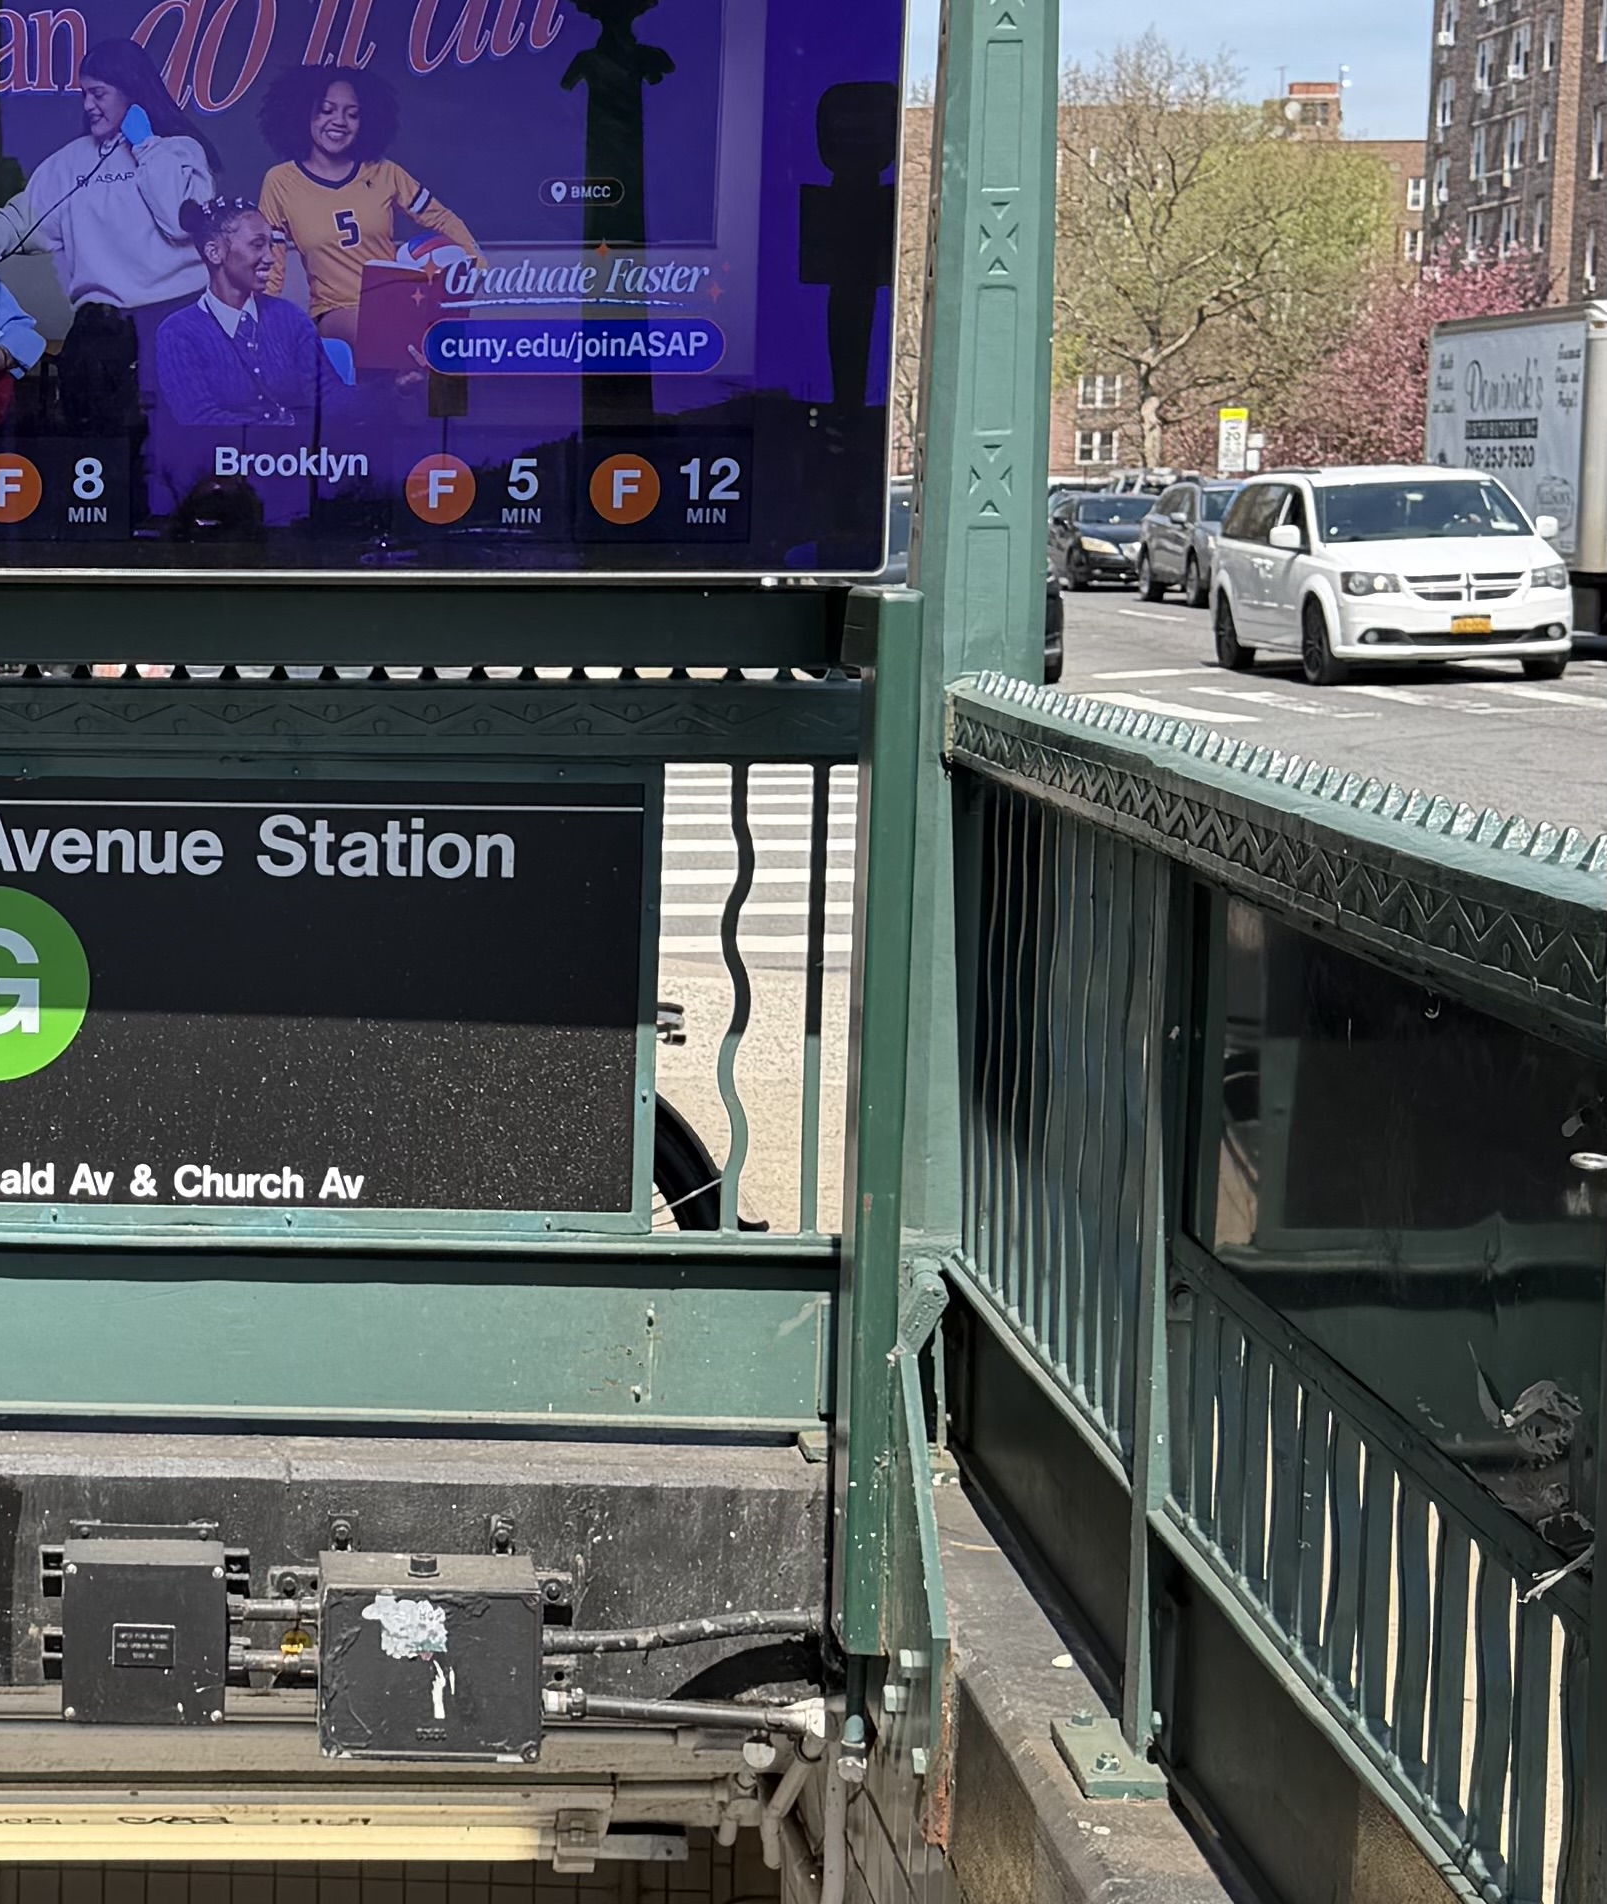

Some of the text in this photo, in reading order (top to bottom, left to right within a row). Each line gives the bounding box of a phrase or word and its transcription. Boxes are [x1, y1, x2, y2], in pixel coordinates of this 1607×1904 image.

[95, 171, 135, 183] ASAP
[570, 185, 611, 199] BMCC
[332, 209, 361, 248] 5
[444, 256, 710, 295] Graduate Faster
[440, 330, 709, 364] cuny.edu/joinASAP
[73, 457, 105, 500] 8
[214, 446, 369, 483] Brooklyn
[507, 457, 539, 501] 5
[679, 457, 741, 501] 12
[428, 469, 458, 508] F
[612, 469, 640, 509] F
[68, 506, 108, 524] MIN
[501, 507, 542, 524] MIN
[686, 507, 727, 524] MIN
[256, 814, 515, 879] Station
[69, 1164, 114, 1197] Av
[129, 1165, 157, 1197] &
[173, 1165, 303, 1199] Church
[319, 1167, 365, 1200] Av
